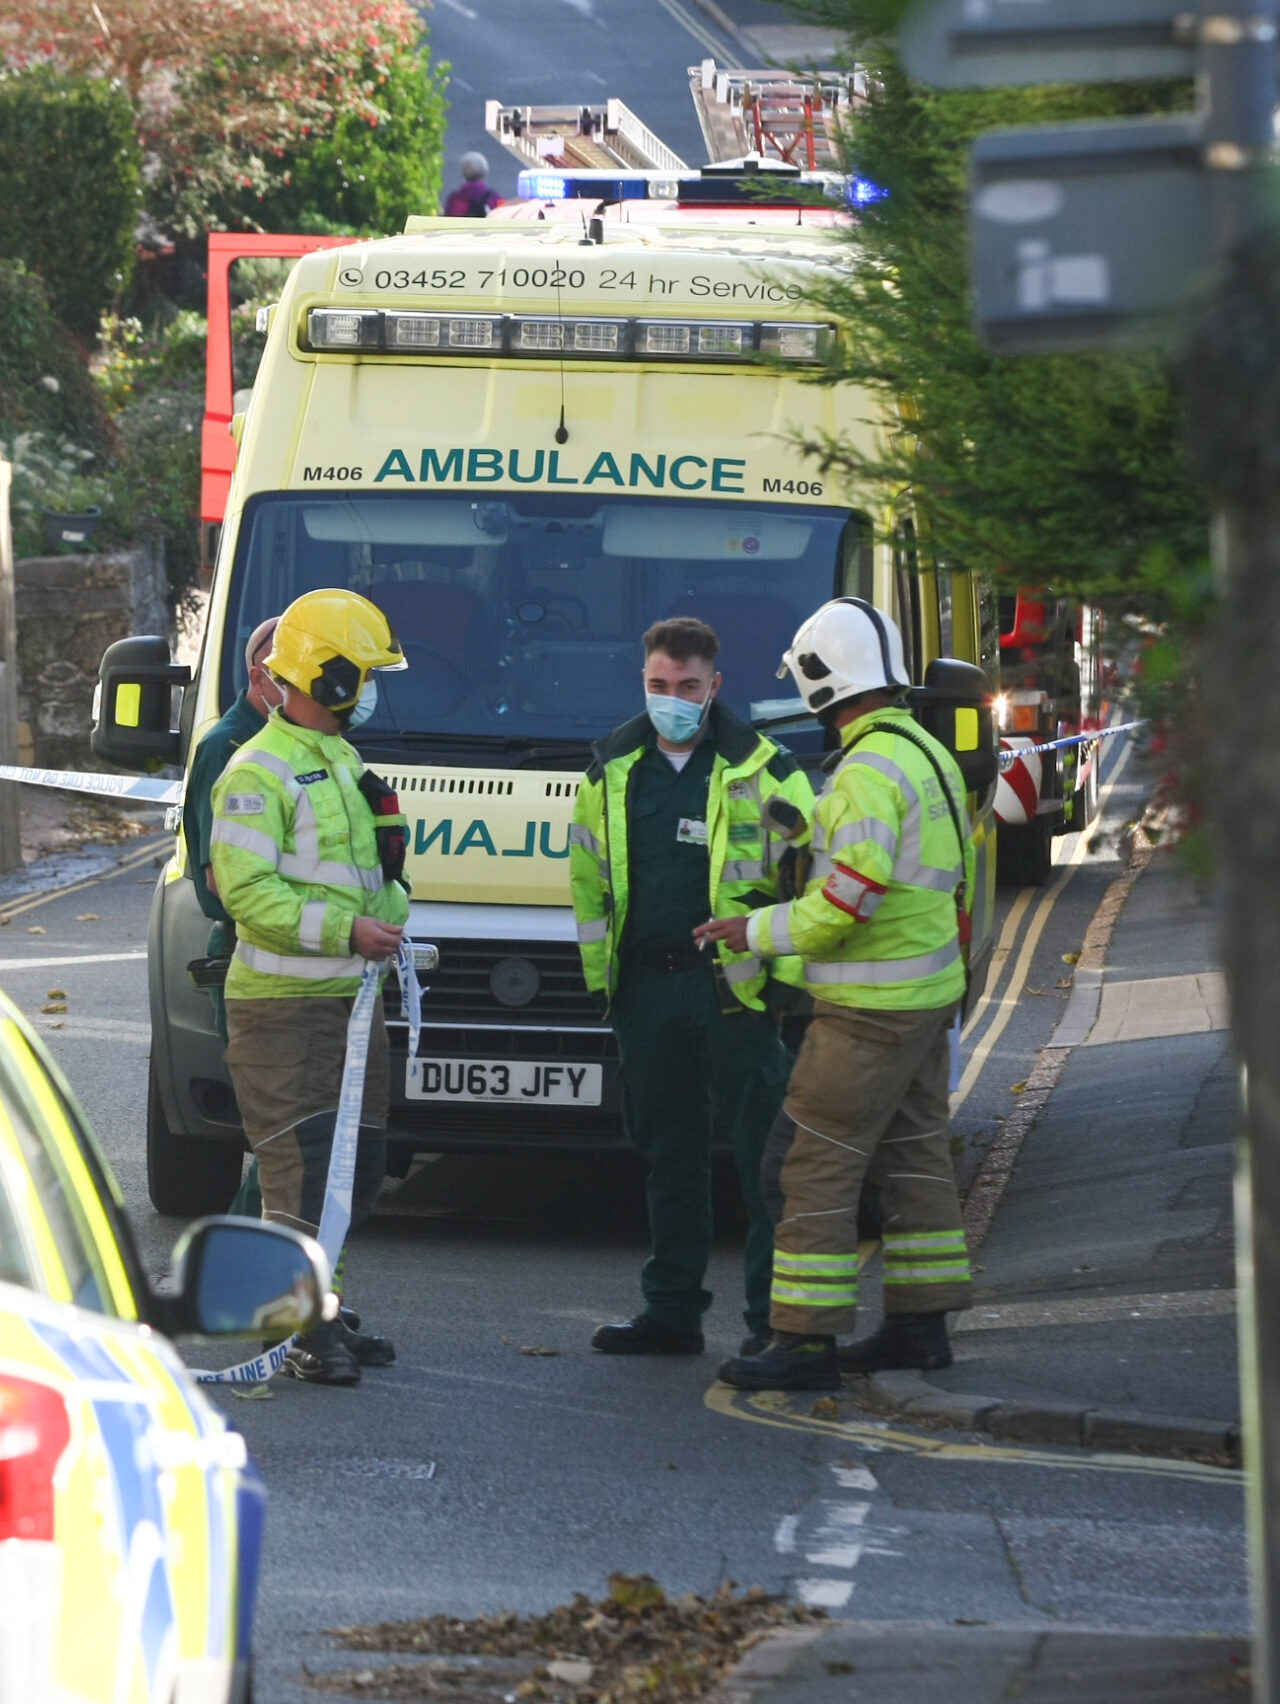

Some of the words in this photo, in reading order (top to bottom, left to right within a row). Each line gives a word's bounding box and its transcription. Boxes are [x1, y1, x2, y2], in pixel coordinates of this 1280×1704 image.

[375, 269, 466, 289] 03452
[478, 269, 586, 289] 710020
[598, 269, 637, 290] 24
[648, 273, 680, 295] hr
[689, 274, 803, 302] Service
[303, 466, 363, 481] M406
[373, 448, 746, 493] AMBULANCE
[762, 478, 824, 497] M406
[422, 1062, 510, 1096] DU63
[521, 1066, 587, 1098] JFY
[231, 1358, 267, 1381] LINE
